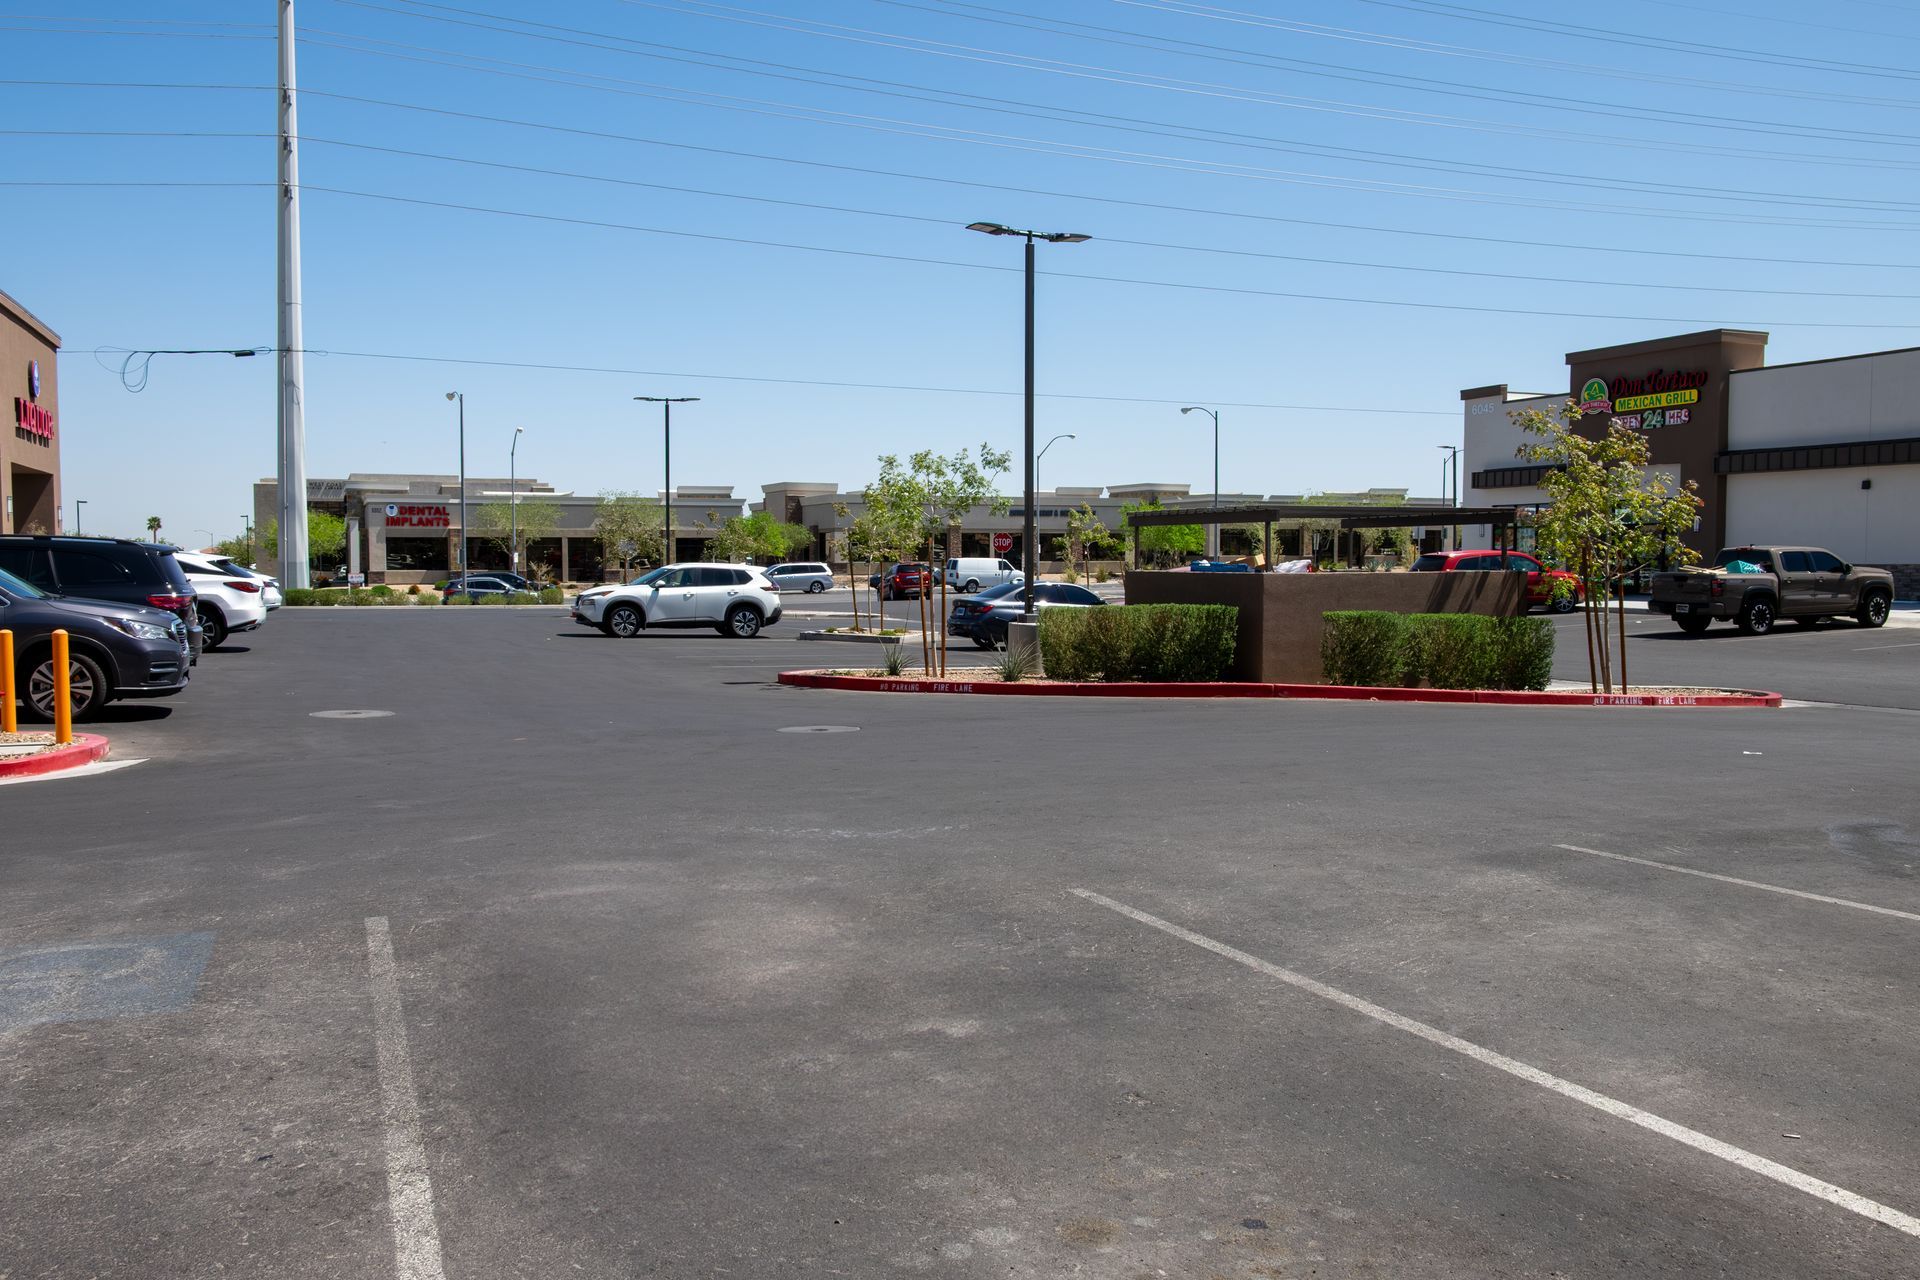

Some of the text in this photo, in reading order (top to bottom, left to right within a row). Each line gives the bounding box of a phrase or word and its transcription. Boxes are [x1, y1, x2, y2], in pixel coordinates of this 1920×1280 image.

[1617, 390, 1696, 410] MEXICAN GRILL
[1472, 402, 1494, 415] 6045
[20, 399, 53, 440] LIQUOR
[1642, 409, 1663, 429] 24
[1665, 408, 1690, 425] HRS
[400, 506, 449, 516] DENTAL
[385, 517, 450, 527] IMPLANTS
[994, 538, 1010, 546] STOP
